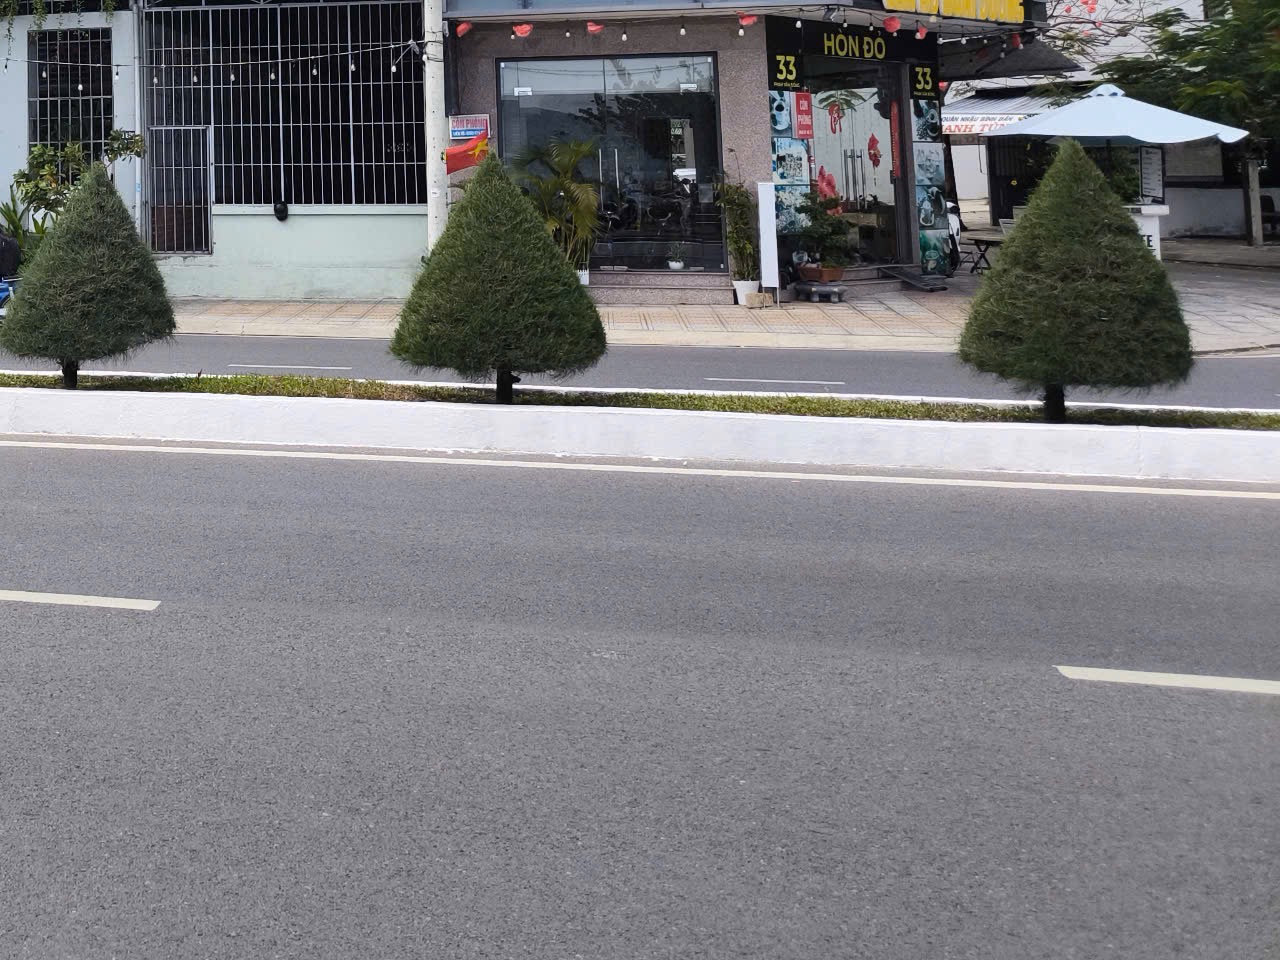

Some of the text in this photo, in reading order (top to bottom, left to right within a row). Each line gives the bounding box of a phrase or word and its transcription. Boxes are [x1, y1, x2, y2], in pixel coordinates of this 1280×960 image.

[823, 28, 886, 59] HÒN ĐỎ
[775, 55, 797, 81] 33
[915, 67, 933, 90] 33
[941, 124, 976, 133] ANH
